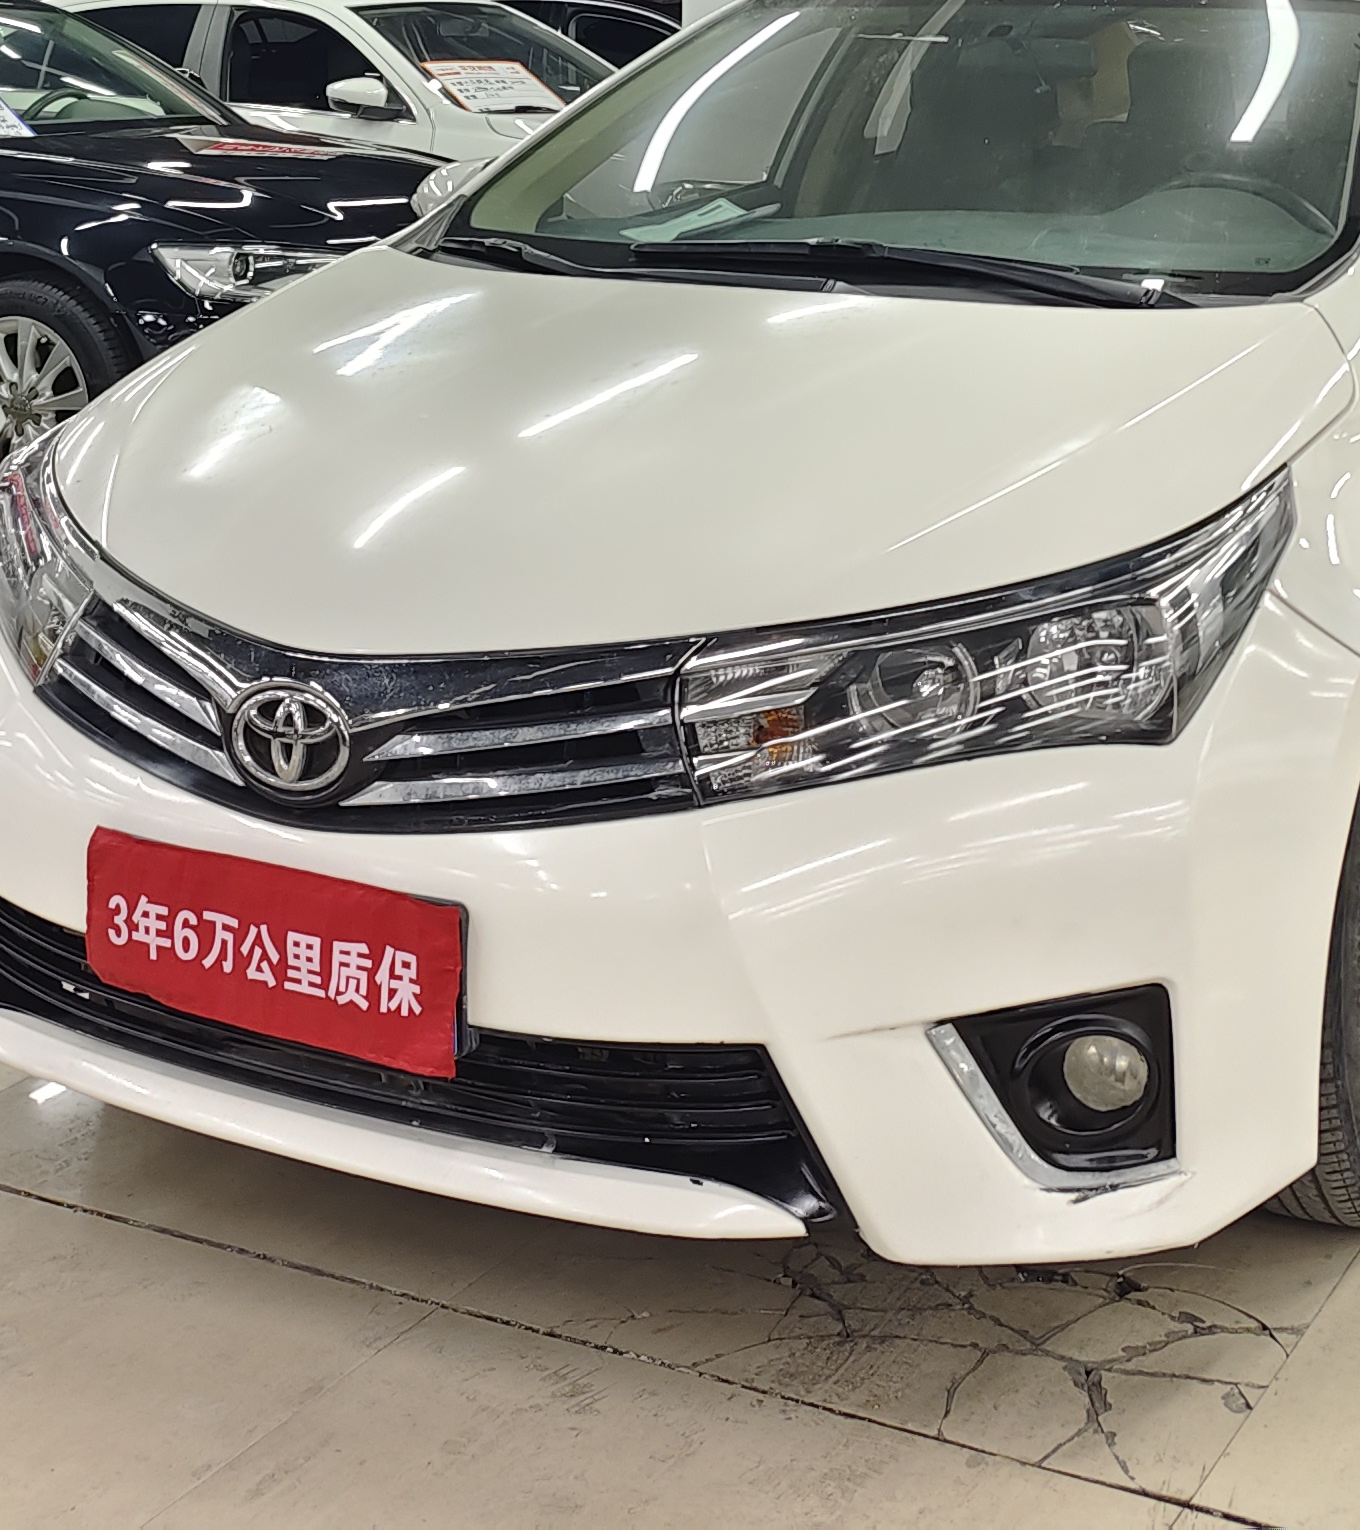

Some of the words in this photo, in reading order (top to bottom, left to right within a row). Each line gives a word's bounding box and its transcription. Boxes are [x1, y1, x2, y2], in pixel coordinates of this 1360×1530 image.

[107, 894, 423, 1017] 3年6万公里质保
